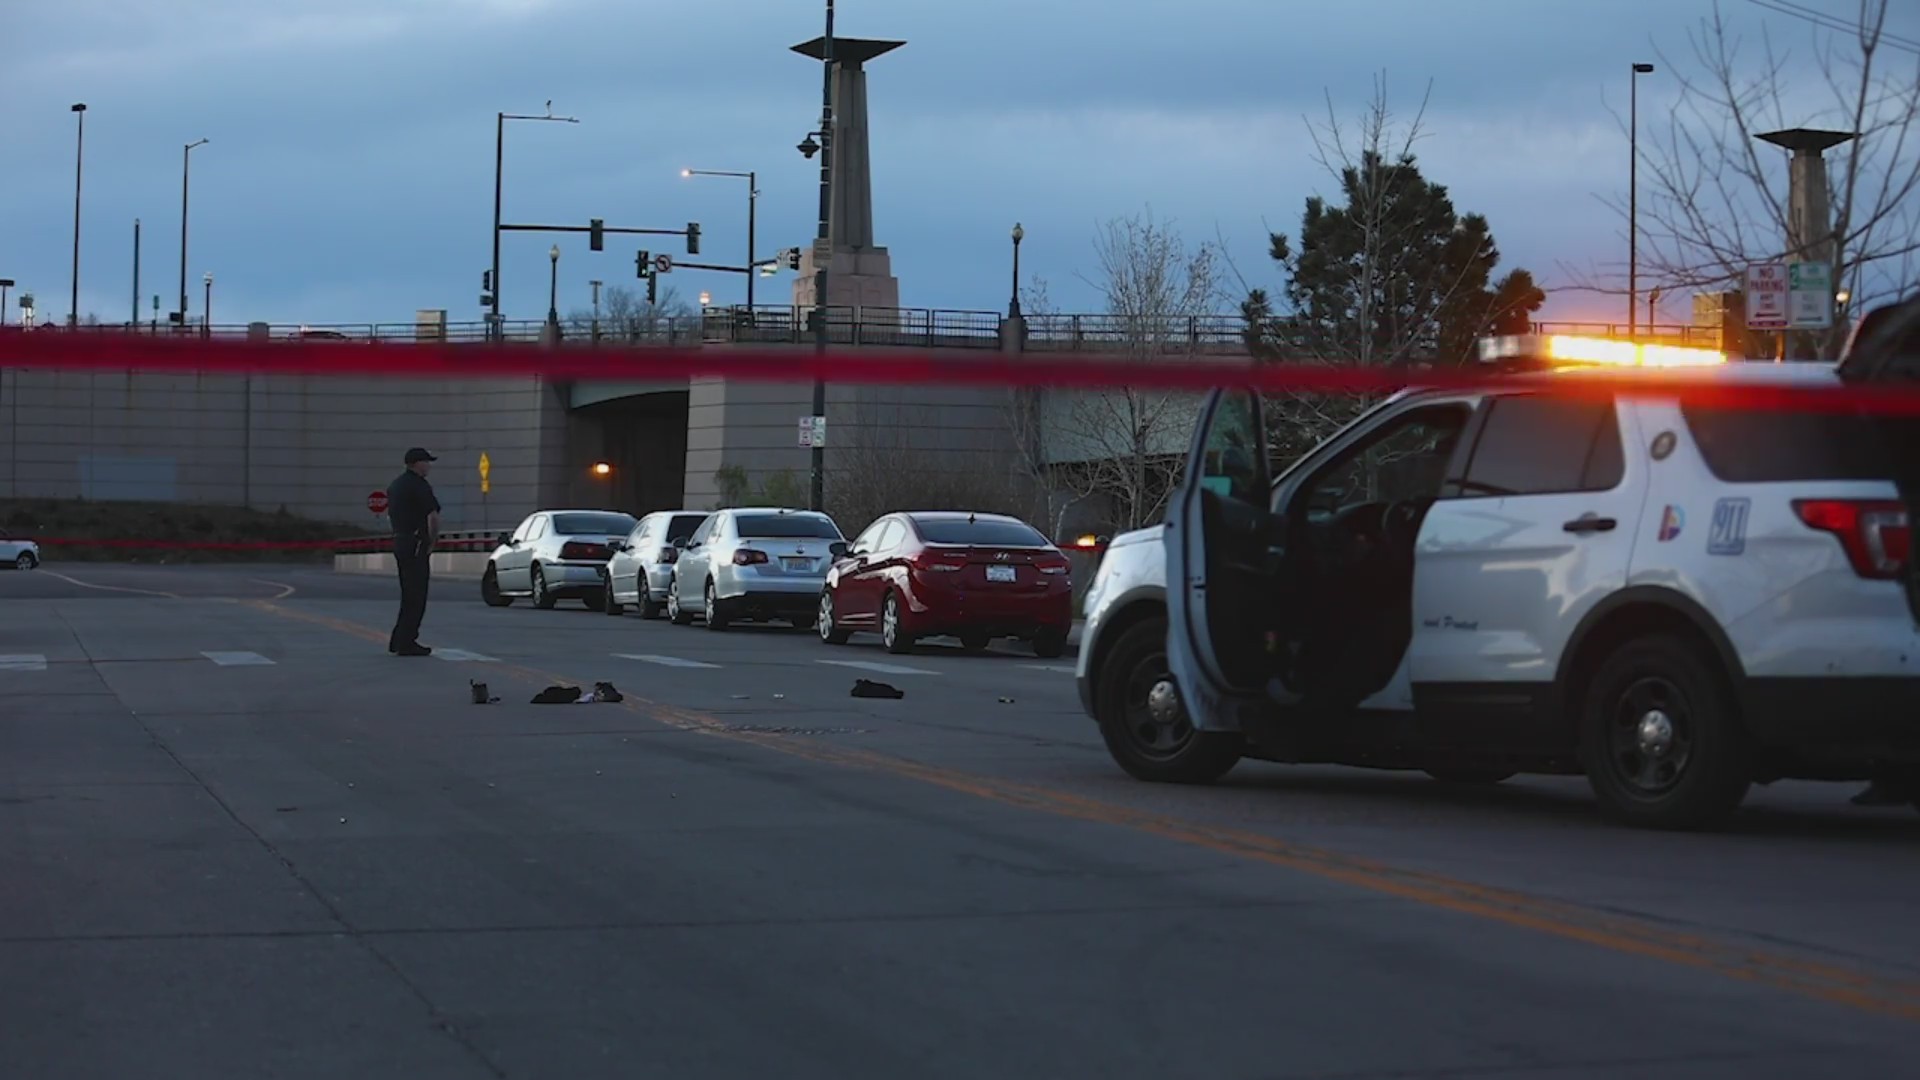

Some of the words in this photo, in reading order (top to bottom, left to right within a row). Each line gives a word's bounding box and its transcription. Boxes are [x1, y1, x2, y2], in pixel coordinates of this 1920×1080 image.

[1759, 267, 1774, 279] NO
[368, 498, 388, 507] STOP
[1713, 504, 1745, 541] 911
